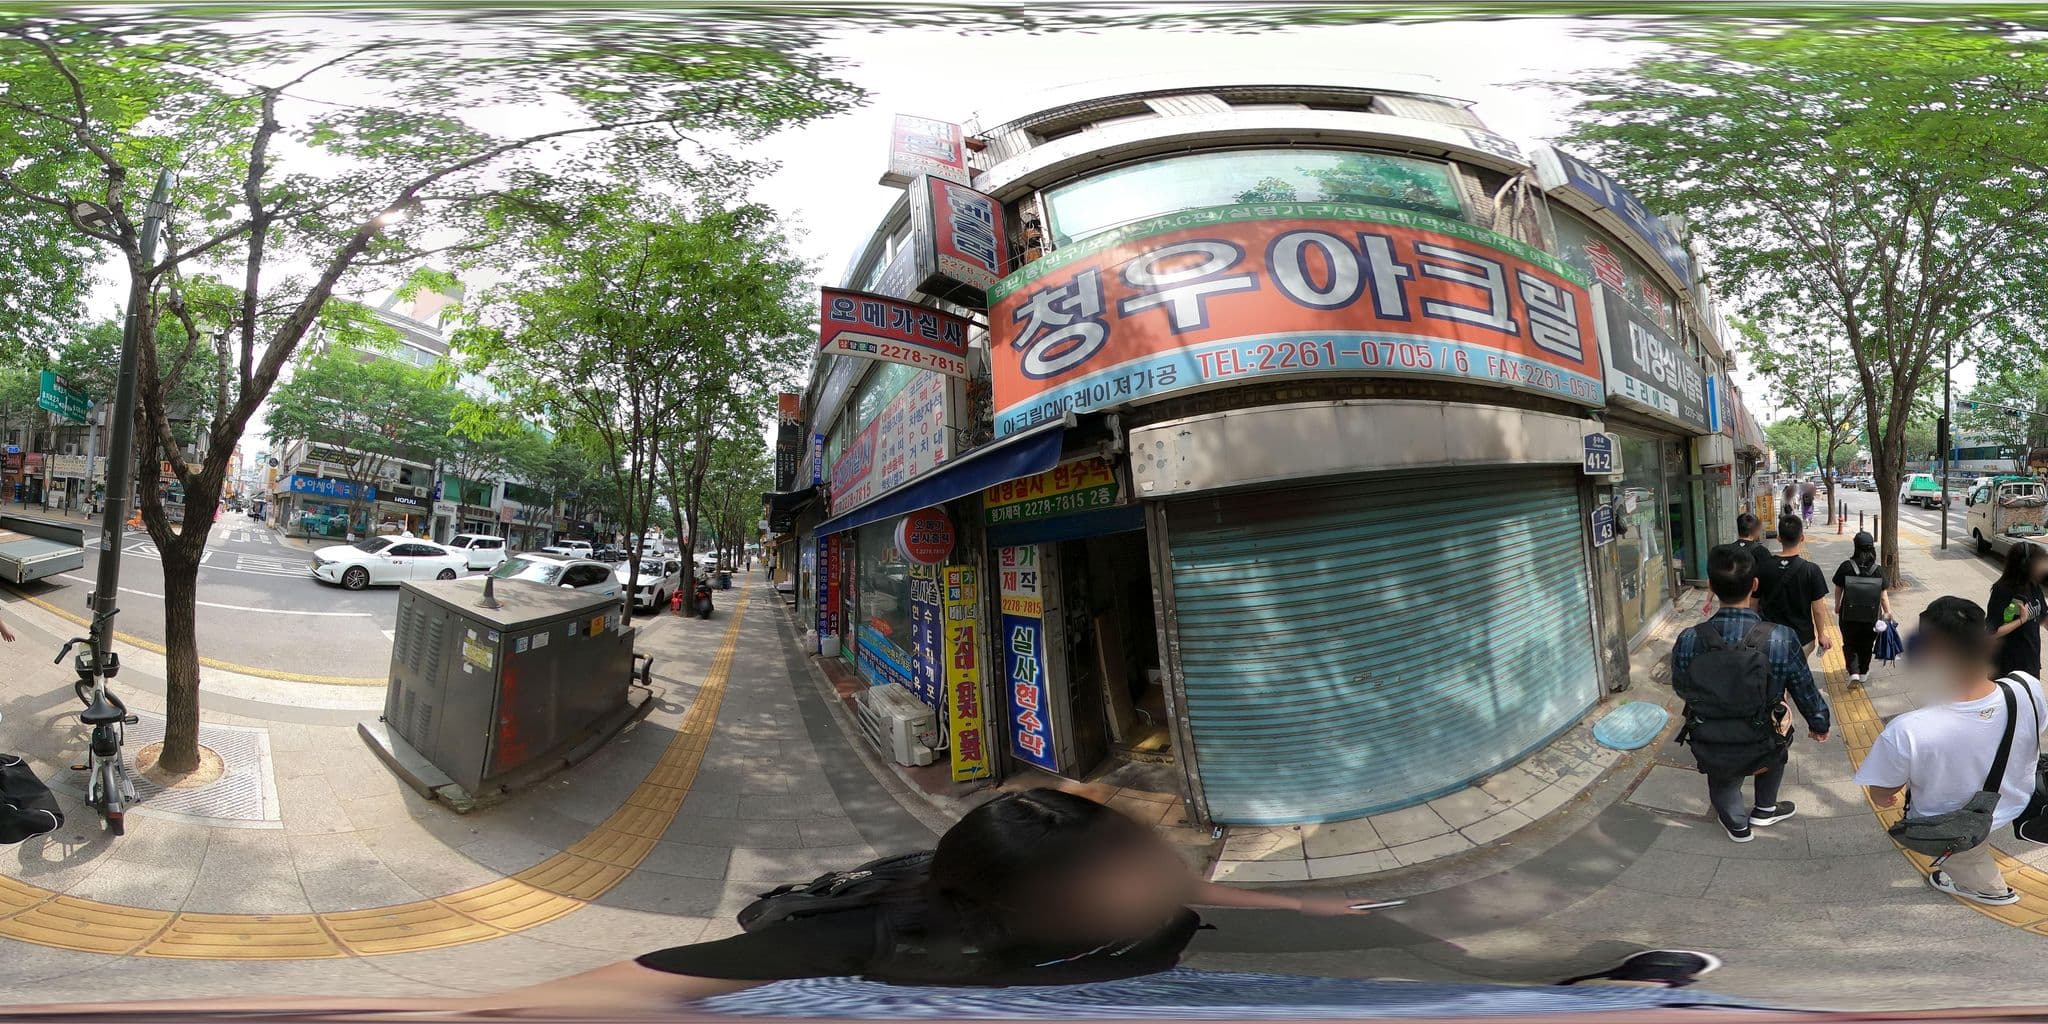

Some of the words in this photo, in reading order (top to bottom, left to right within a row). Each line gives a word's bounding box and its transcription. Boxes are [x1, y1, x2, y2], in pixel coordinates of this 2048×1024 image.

[1010, 228, 1584, 380] 청우아크릴
[829, 296, 963, 348] 오메가실사
[880, 344, 965, 375] 2278-7815
[1196, 334, 1433, 378] TEL:2261-0705
[1486, 354, 1599, 401] FAX:2261-0575
[1587, 452, 1611, 470] 41-2
[1025, 492, 1085, 517] 2278-7815
[1601, 524, 1613, 538] 43
[1001, 545, 1036, 567] 원가
[1002, 571, 1037, 593] 제작
[1002, 598, 1042, 615] 2278-7815
[1011, 624, 1045, 756] 실사현수막
